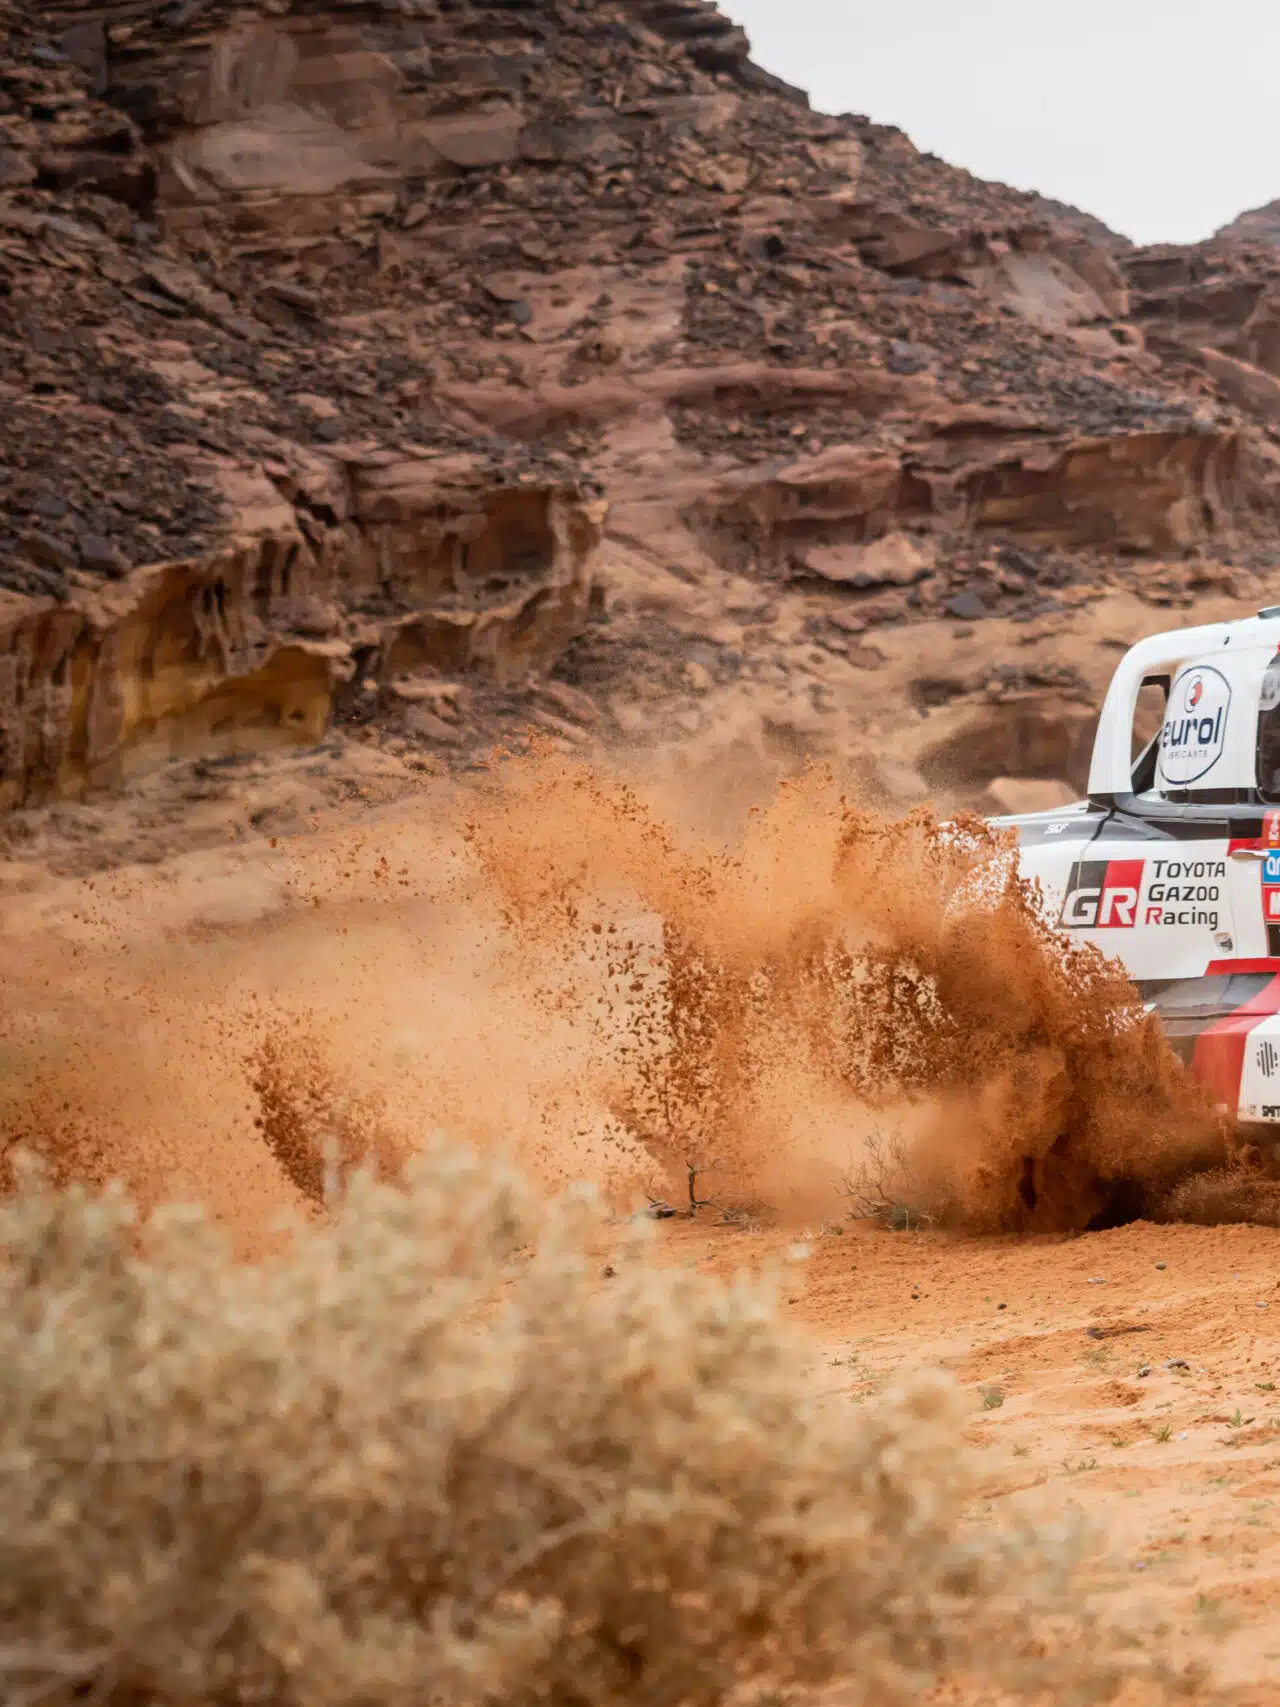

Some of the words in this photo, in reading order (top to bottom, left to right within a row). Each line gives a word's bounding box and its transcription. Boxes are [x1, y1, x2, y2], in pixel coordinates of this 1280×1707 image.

[1152, 860, 1226, 879] TOYOTA
[1148, 884, 1219, 902] GAZOO
[1061, 887, 1138, 926] GR
[1145, 906, 1219, 931] Racing
